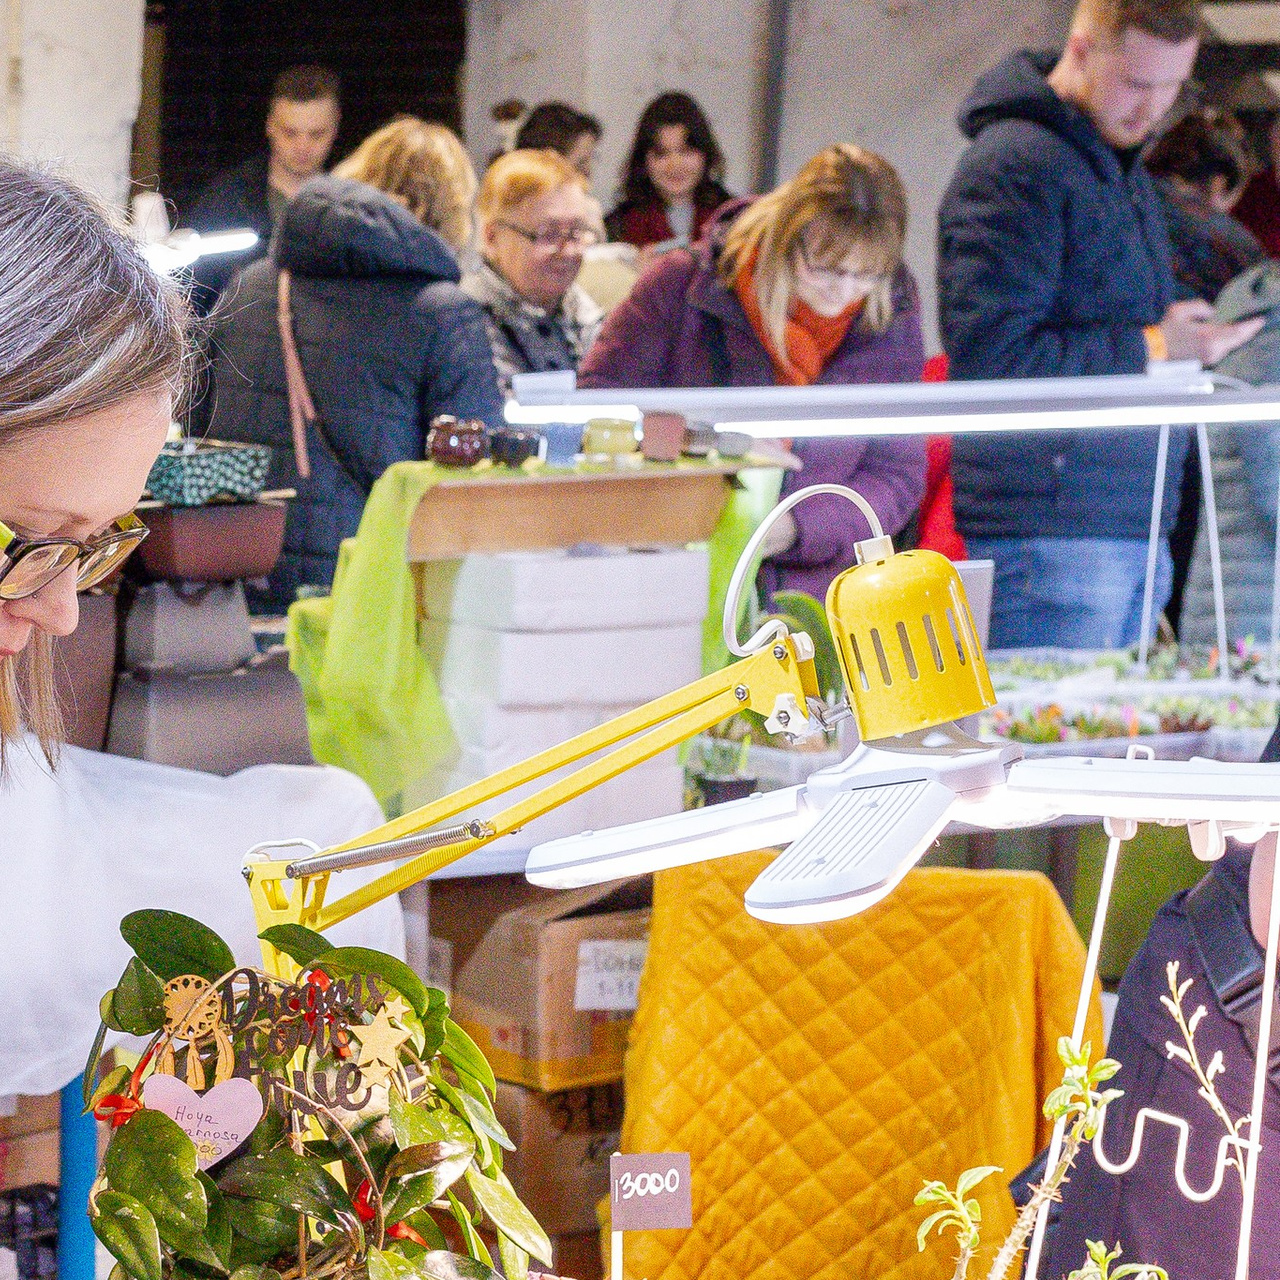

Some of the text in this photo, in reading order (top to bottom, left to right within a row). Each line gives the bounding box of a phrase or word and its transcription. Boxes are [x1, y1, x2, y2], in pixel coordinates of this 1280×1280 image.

[234, 1054, 372, 1118] true
[175, 1105, 218, 1127] Hoya
[184, 1128, 241, 1143] arnosa
[620, 1168, 680, 1200] 3000
